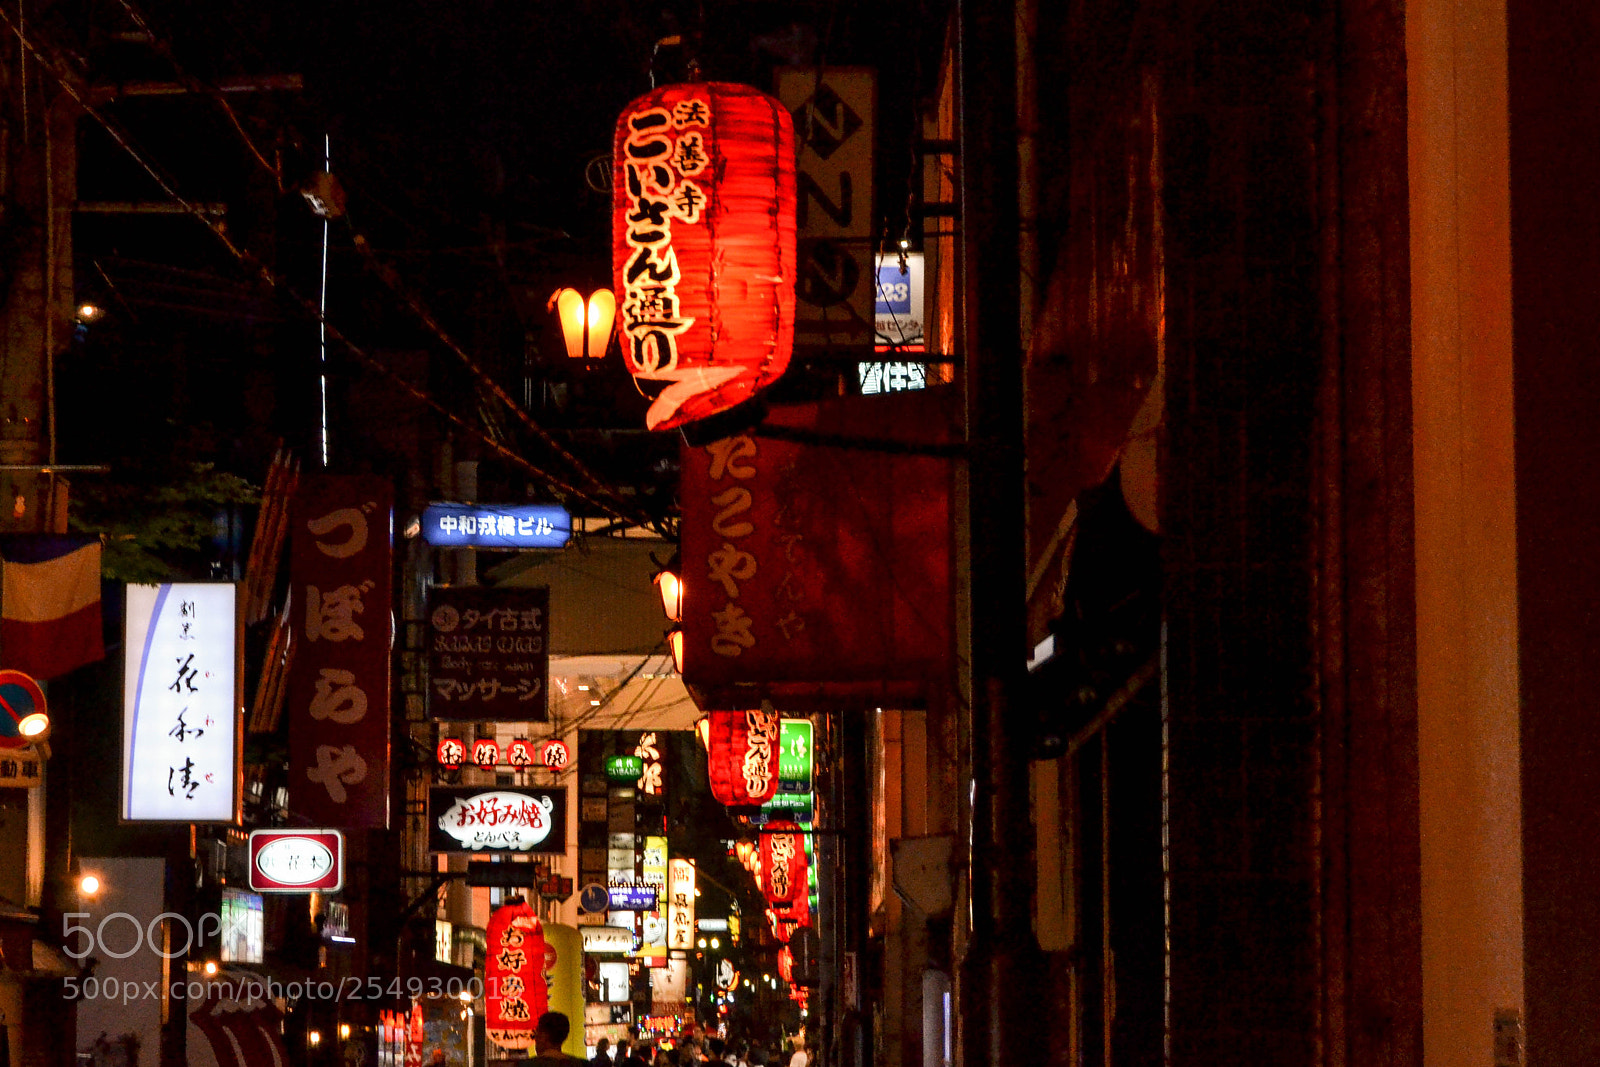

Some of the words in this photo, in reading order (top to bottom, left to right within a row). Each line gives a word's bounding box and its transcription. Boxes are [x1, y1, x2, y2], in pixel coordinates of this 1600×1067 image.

[671, 100, 710, 225] 法善寺
[705, 433, 757, 658] たこやき
[306, 501, 378, 804] づぼらや
[461, 607, 542, 632] タイ古式
[432, 678, 541, 701] マッサージ
[456, 797, 543, 828] お好み焼
